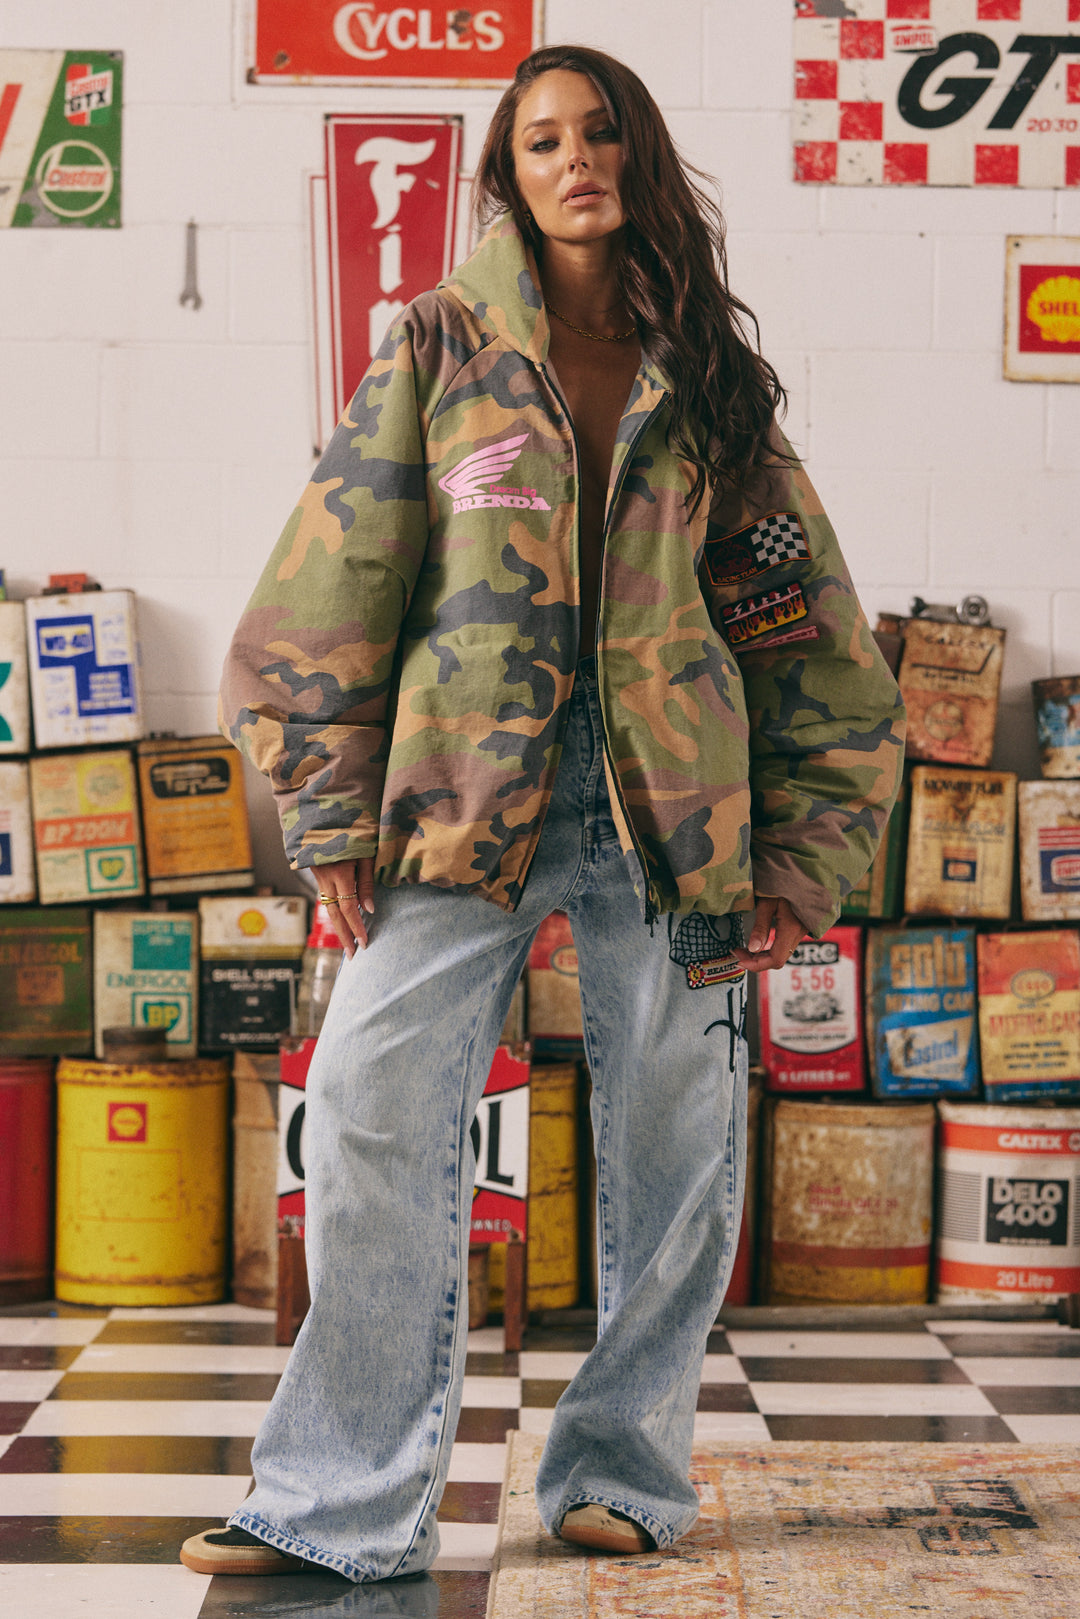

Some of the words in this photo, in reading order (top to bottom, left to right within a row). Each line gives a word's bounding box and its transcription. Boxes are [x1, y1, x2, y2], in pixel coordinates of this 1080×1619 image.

[333, 3, 504, 60] CYCLES
[70, 90, 106, 112] GTX
[48, 169, 107, 187] Castrol
[1038, 301, 1080, 316] SHEL
[490, 484, 520, 496] Dream
[522, 486, 537, 498] Big
[452, 494, 552, 514] BRENDA
[788, 943, 838, 963] CRC
[707, 961, 738, 976] BEAUT
[147, 1004, 180, 1028] BP
[998, 1133, 1063, 1149] CALTEX
[992, 1178, 1064, 1205] DELO
[995, 1203, 1058, 1227] 400
[471, 1218, 512, 1232] WNED
[996, 1271, 1017, 1288] 20
[1018, 1271, 1055, 1289] Litre
